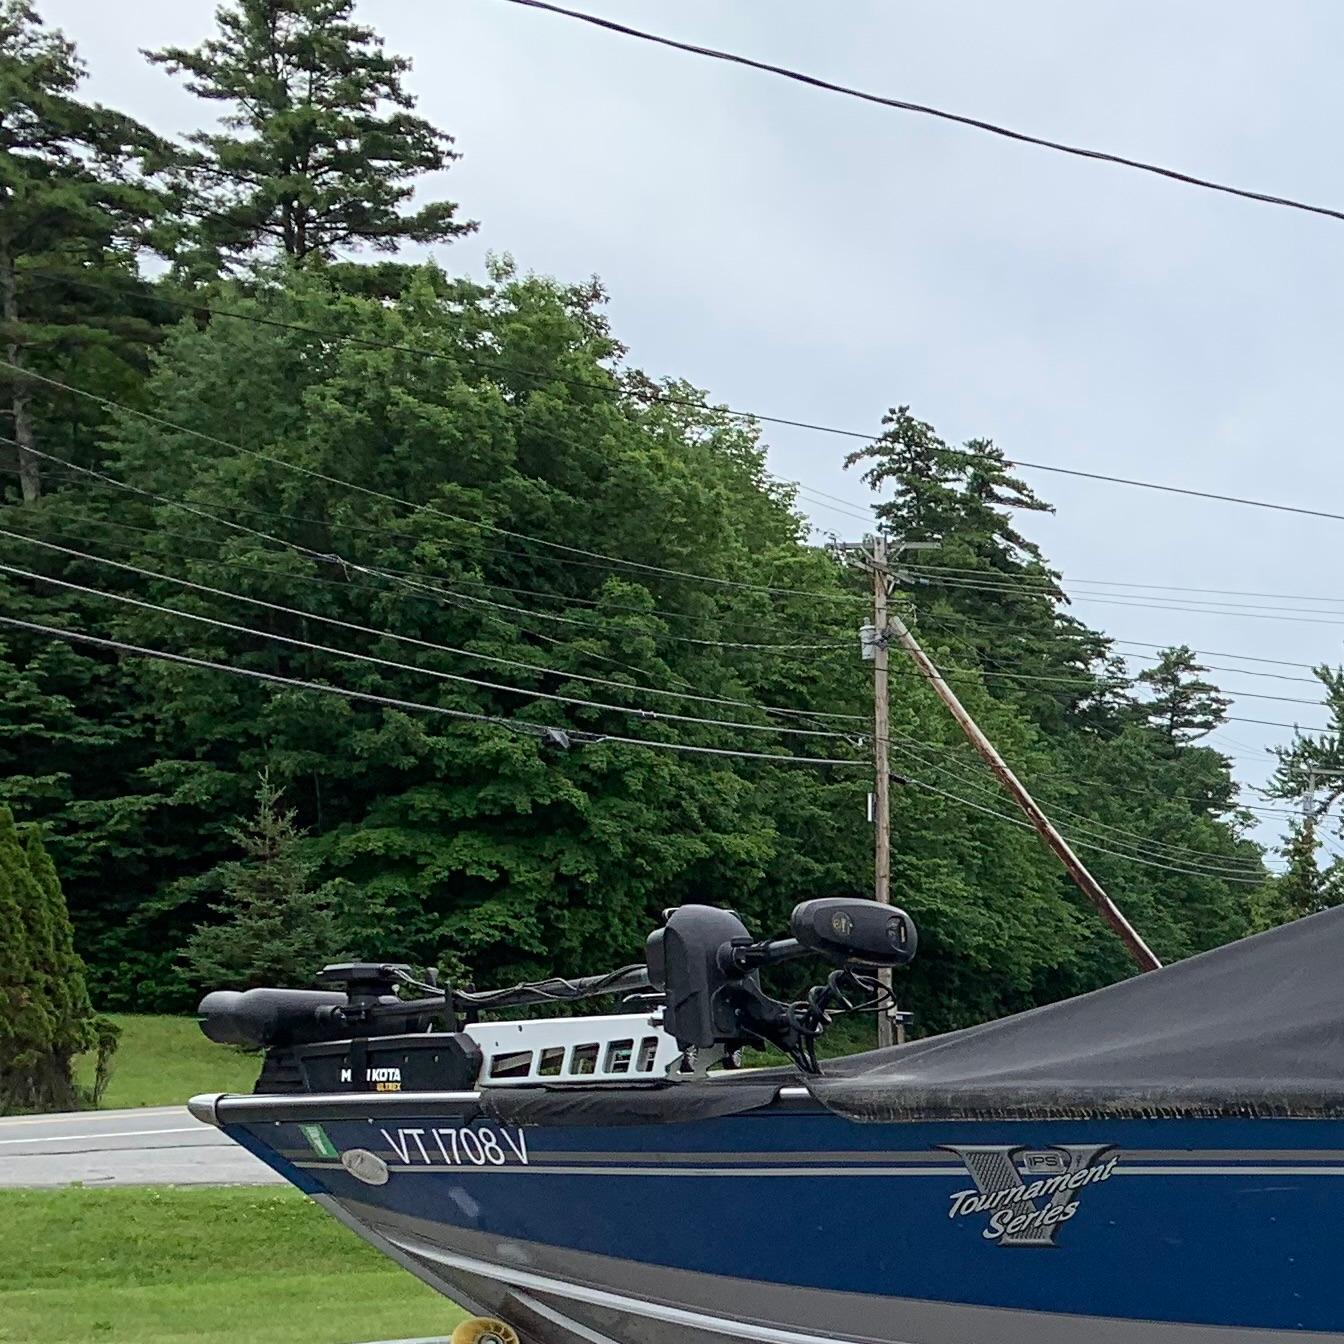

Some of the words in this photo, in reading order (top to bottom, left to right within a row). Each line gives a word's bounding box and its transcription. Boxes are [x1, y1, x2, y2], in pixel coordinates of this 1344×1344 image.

[371, 1067, 401, 1082] KOTA
[380, 1127, 432, 1165] VT
[431, 1127, 506, 1166] 1708
[500, 1127, 529, 1165] V
[1028, 1156, 1059, 1167] IPS
[948, 1154, 1120, 1220] Tournament
[981, 1200, 1081, 1240] Series
